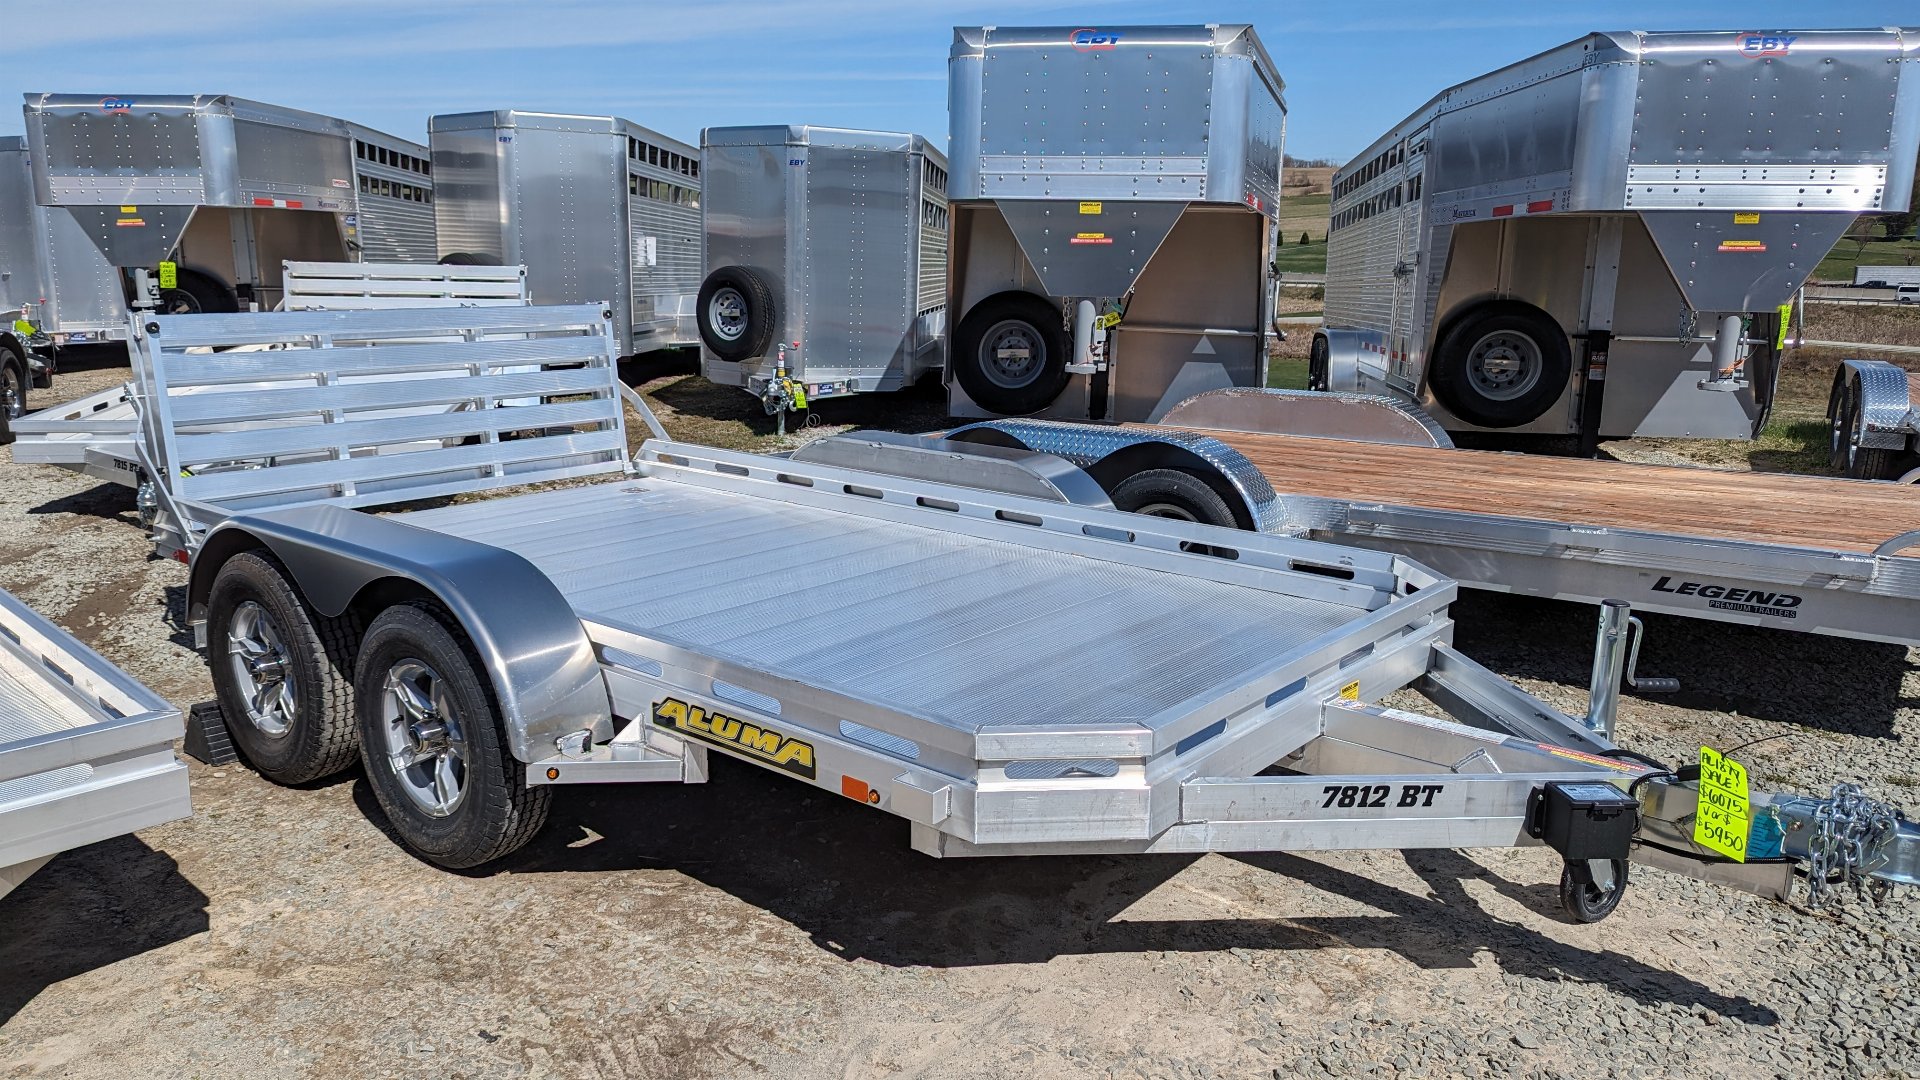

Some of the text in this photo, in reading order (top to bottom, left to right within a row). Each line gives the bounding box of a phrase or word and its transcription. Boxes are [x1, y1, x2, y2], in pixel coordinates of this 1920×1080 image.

[1075, 31, 1123, 44] EBY
[1743, 36, 1798, 50] EBY
[1651, 576, 1803, 608] LEGEND
[1709, 600, 1796, 618] PREMIUM TRAILERS
[656, 699, 813, 768] ALUMA
[1321, 785, 1445, 808] 7812 BT
[1700, 784, 1743, 813] $6075
[1696, 816, 1744, 852] $5950
